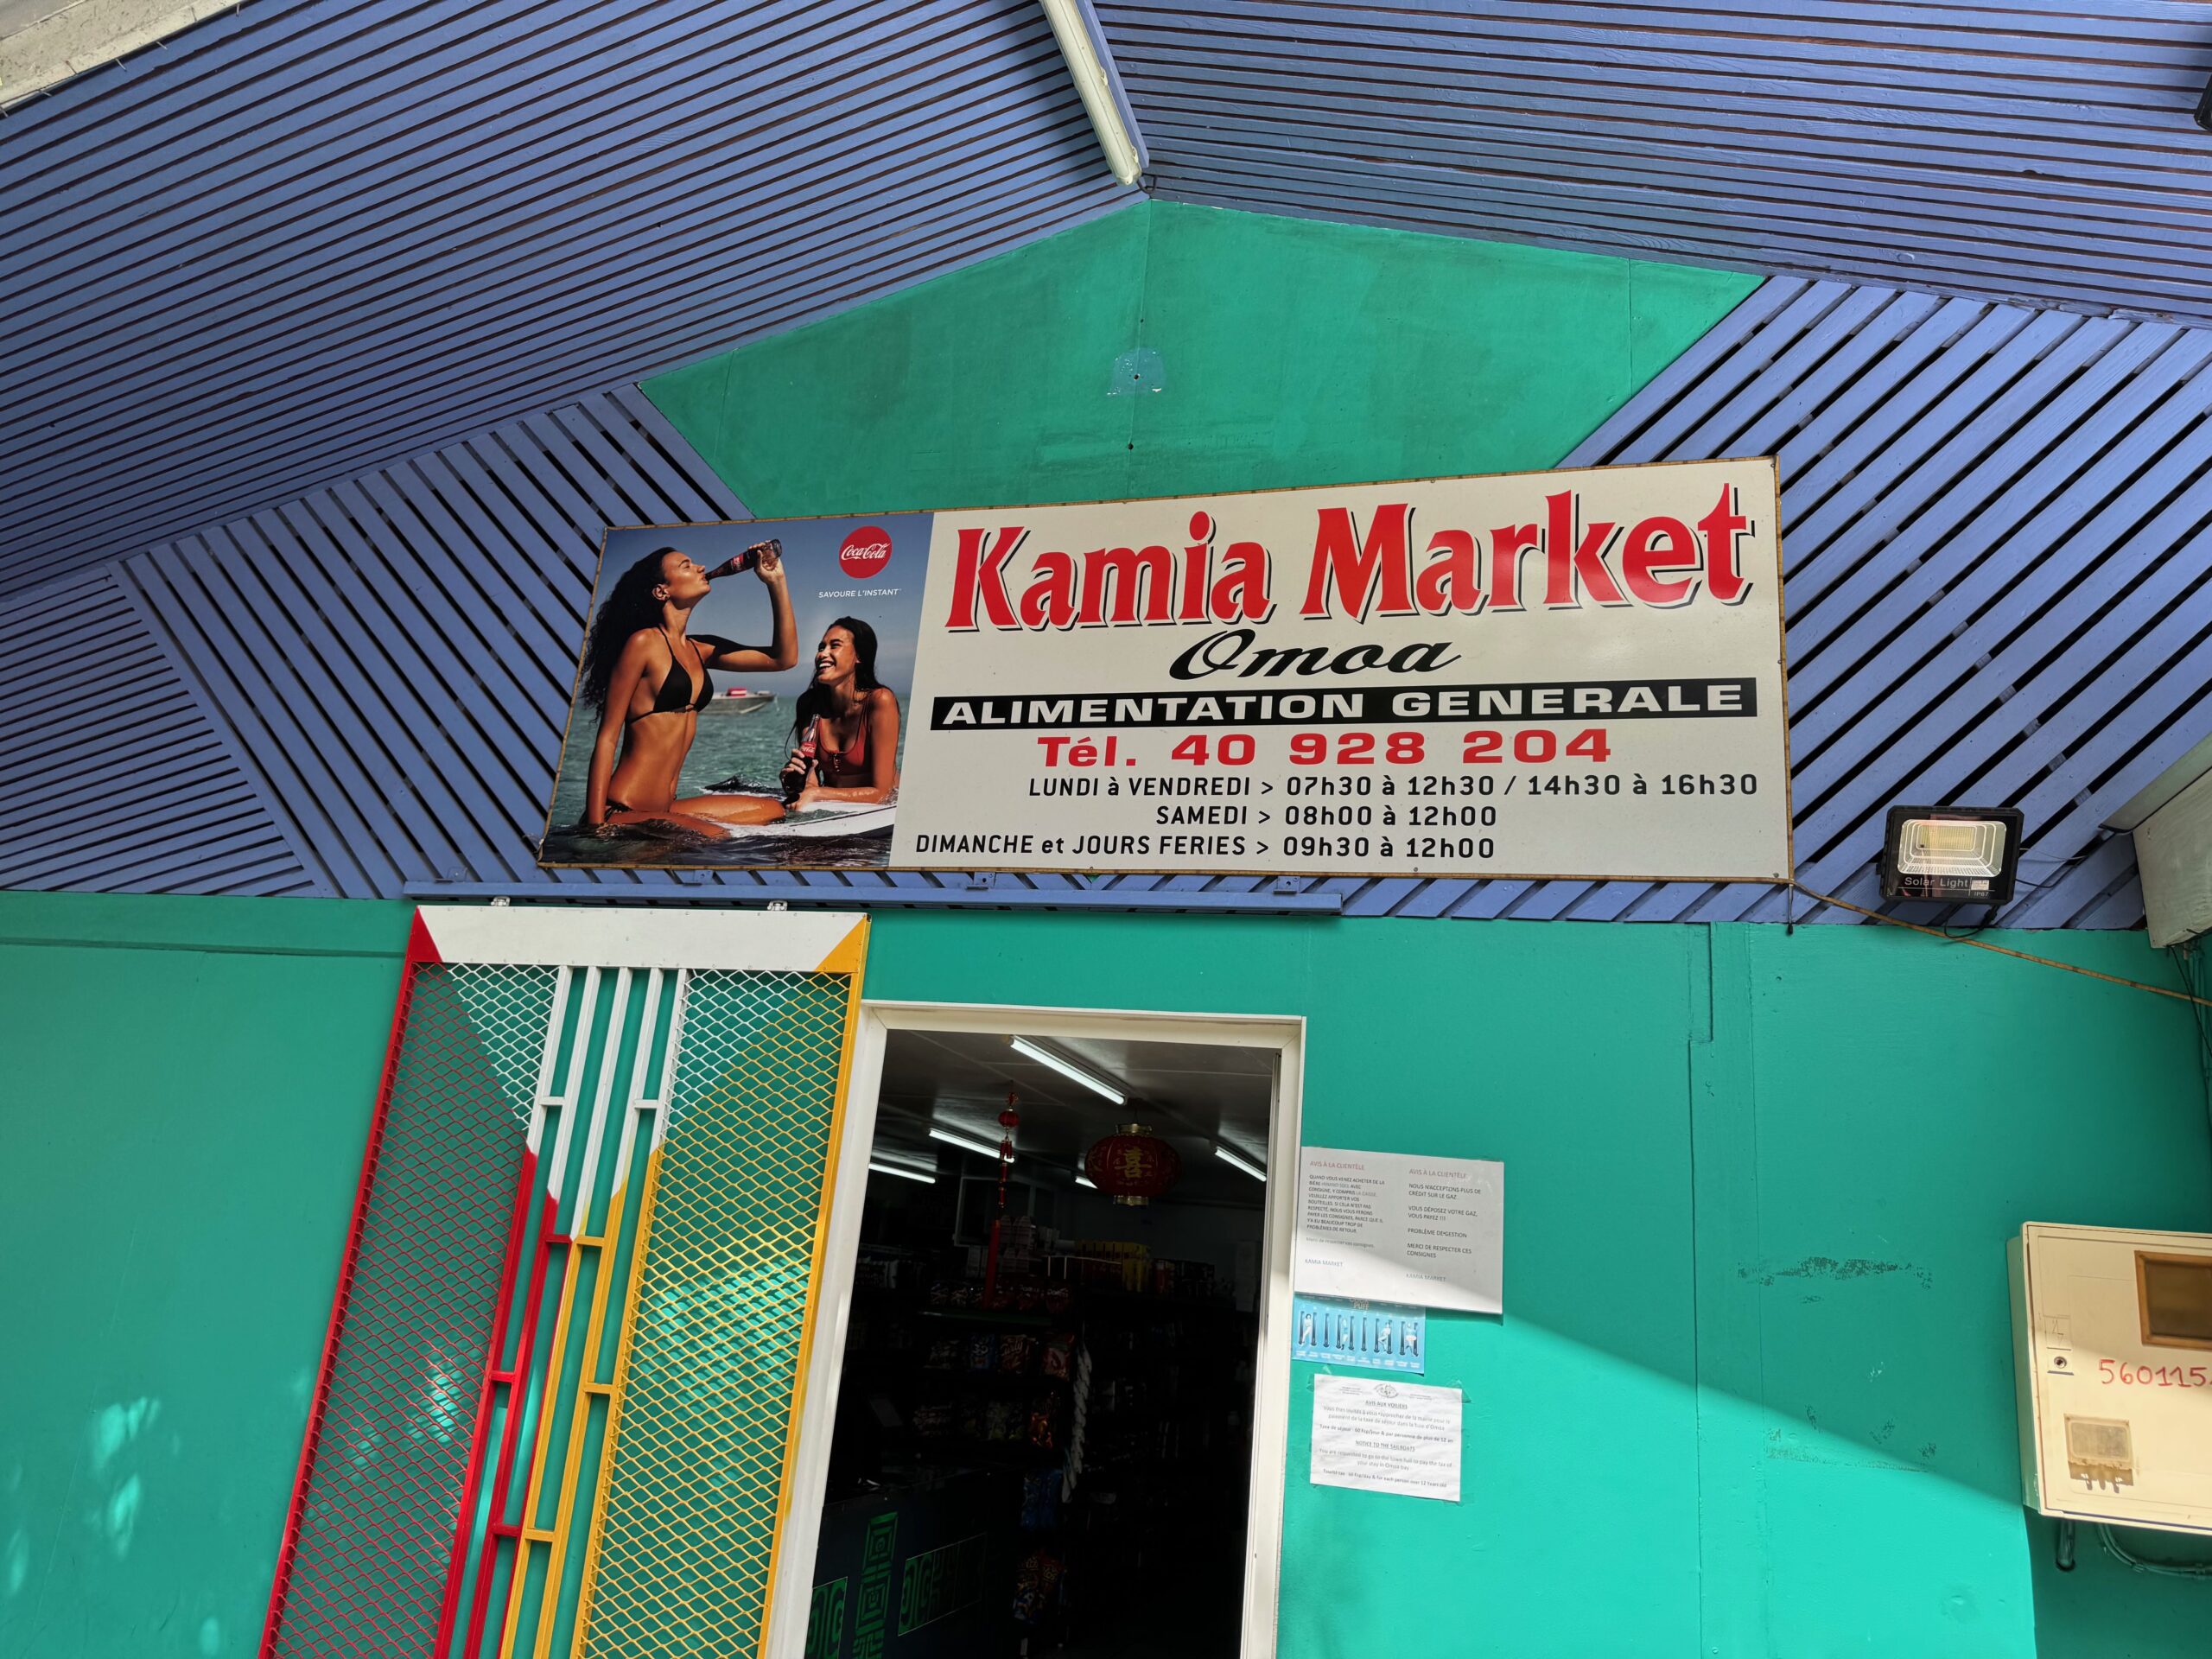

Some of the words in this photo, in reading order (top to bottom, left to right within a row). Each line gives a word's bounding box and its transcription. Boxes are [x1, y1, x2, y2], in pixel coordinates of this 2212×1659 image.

[841, 543, 891, 560] Coca-Cola
[944, 511, 1277, 632] Kamia
[1299, 482, 1756, 625] Market
[818, 590, 856, 599] SAVOURE
[857, 588, 899, 597] L'INSTANT
[1169, 628, 1462, 680] Omoa
[942, 694, 1363, 725] ALIMENTATION
[1391, 684, 1742, 717] GENERALE
[1037, 735, 1136, 766] Tél.
[1171, 734, 1255, 766] 40
[1288, 731, 1425, 766] 928
[1462, 728, 1611, 764] 204
[1029, 778, 1098, 796] LUNDI
[1108, 776, 1120, 796] à
[1128, 777, 1250, 796] VENDREDI
[1287, 776, 1371, 796] 07h30
[1382, 774, 1395, 796] à
[1408, 775, 1494, 796] 12h30
[1528, 774, 1620, 796] 14h30
[1633, 773, 1648, 796] à
[1661, 773, 1758, 795] 16h30
[1156, 805, 1247, 825] SAMEDI
[1285, 805, 1372, 825] 08h00
[1382, 804, 1396, 825] à
[1408, 805, 1497, 826] 12h00
[915, 834, 1033, 853] DIMANCHE
[1041, 837, 1065, 854] et
[1072, 836, 1150, 855] JOURS
[1159, 836, 1246, 855] FERIES
[1283, 836, 1370, 856] 09h30
[1380, 836, 1393, 857] à
[1406, 837, 1494, 858] 12h00
[1904, 876, 1935, 886] Solar
[1940, 878, 1968, 888] Light
[2099, 1358, 2212, 1387] 560115
